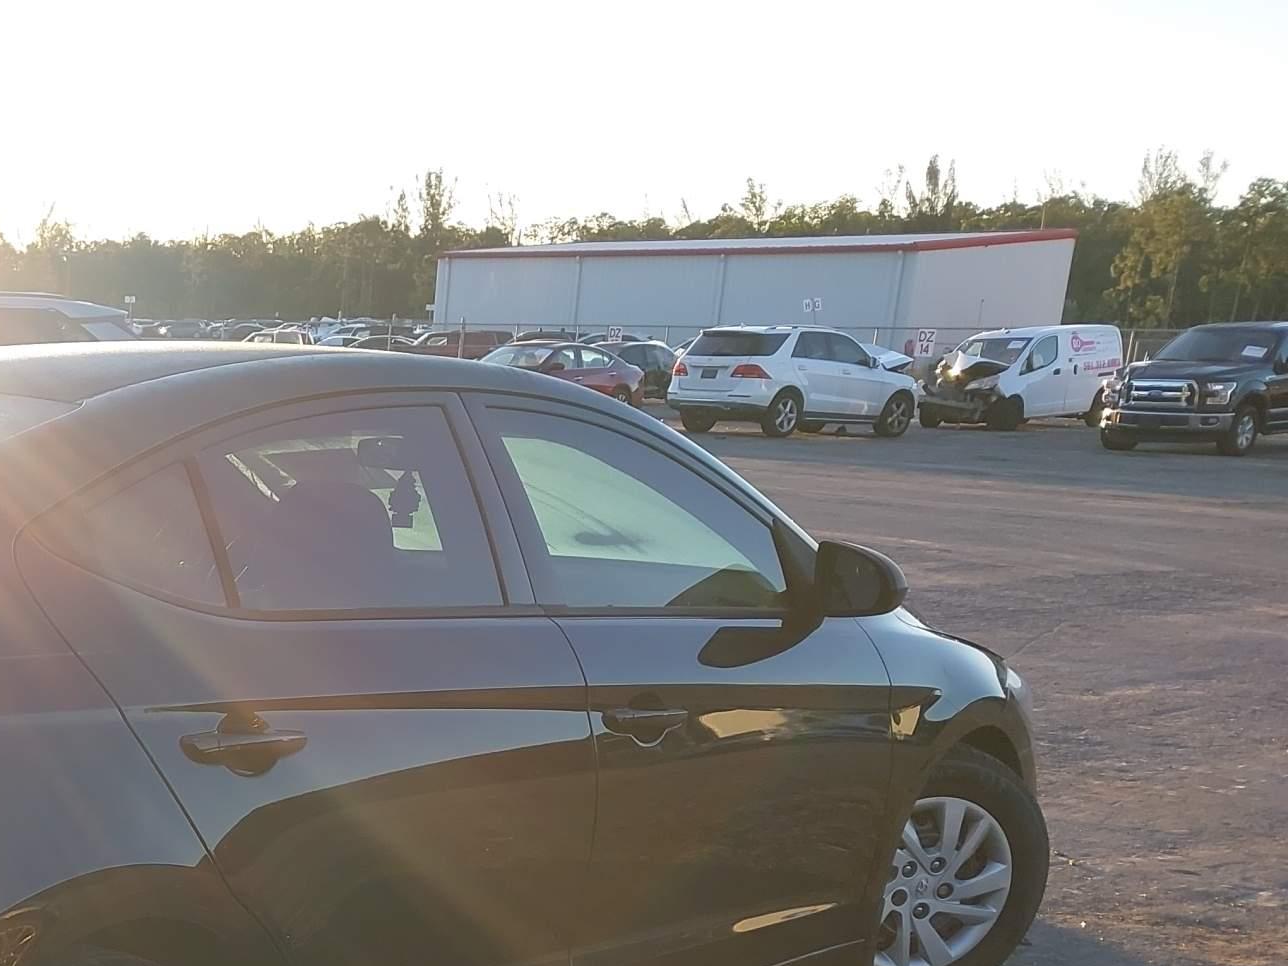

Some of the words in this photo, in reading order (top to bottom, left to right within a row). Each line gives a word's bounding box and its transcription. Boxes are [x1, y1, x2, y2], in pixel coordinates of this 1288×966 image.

[609, 327, 621, 338] DZ
[919, 331, 935, 342] DZ
[920, 343, 929, 354] 14
